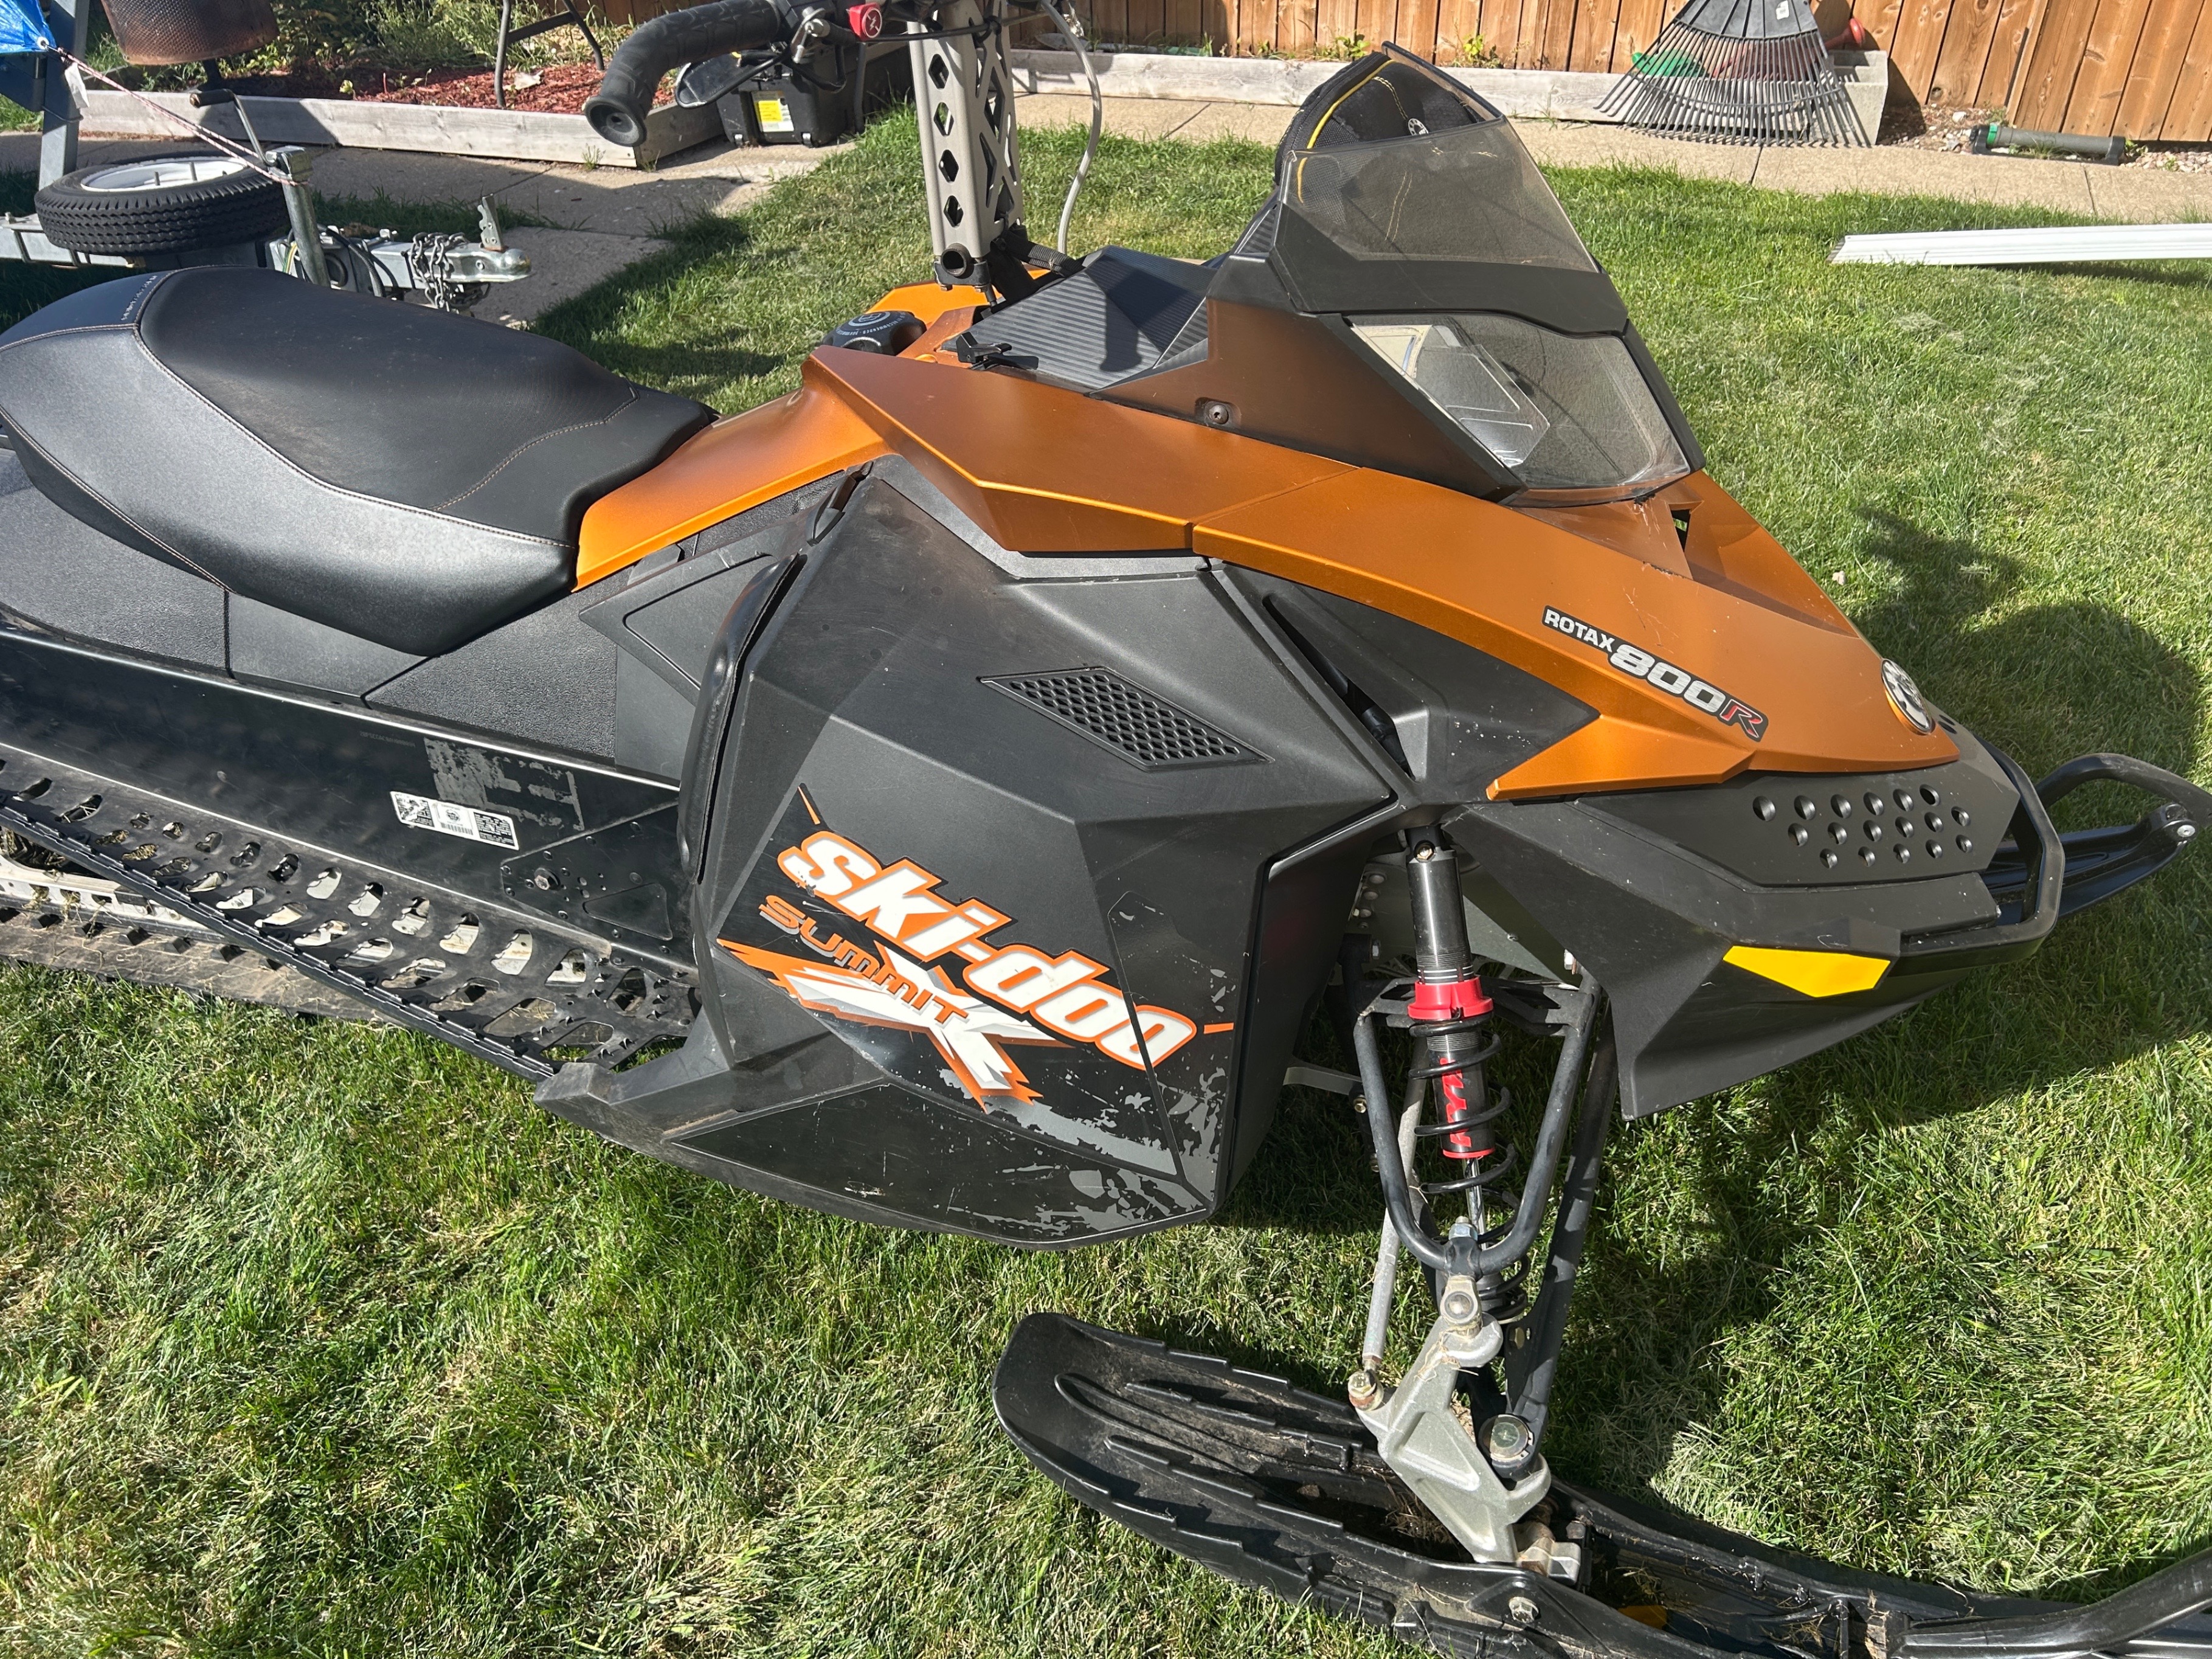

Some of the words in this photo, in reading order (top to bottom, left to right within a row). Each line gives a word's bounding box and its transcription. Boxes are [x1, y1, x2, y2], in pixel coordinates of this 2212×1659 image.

[1544, 608, 1615, 652] ROTAX
[1610, 643, 1763, 738] 800R
[758, 895, 971, 1027] SUMMIT
